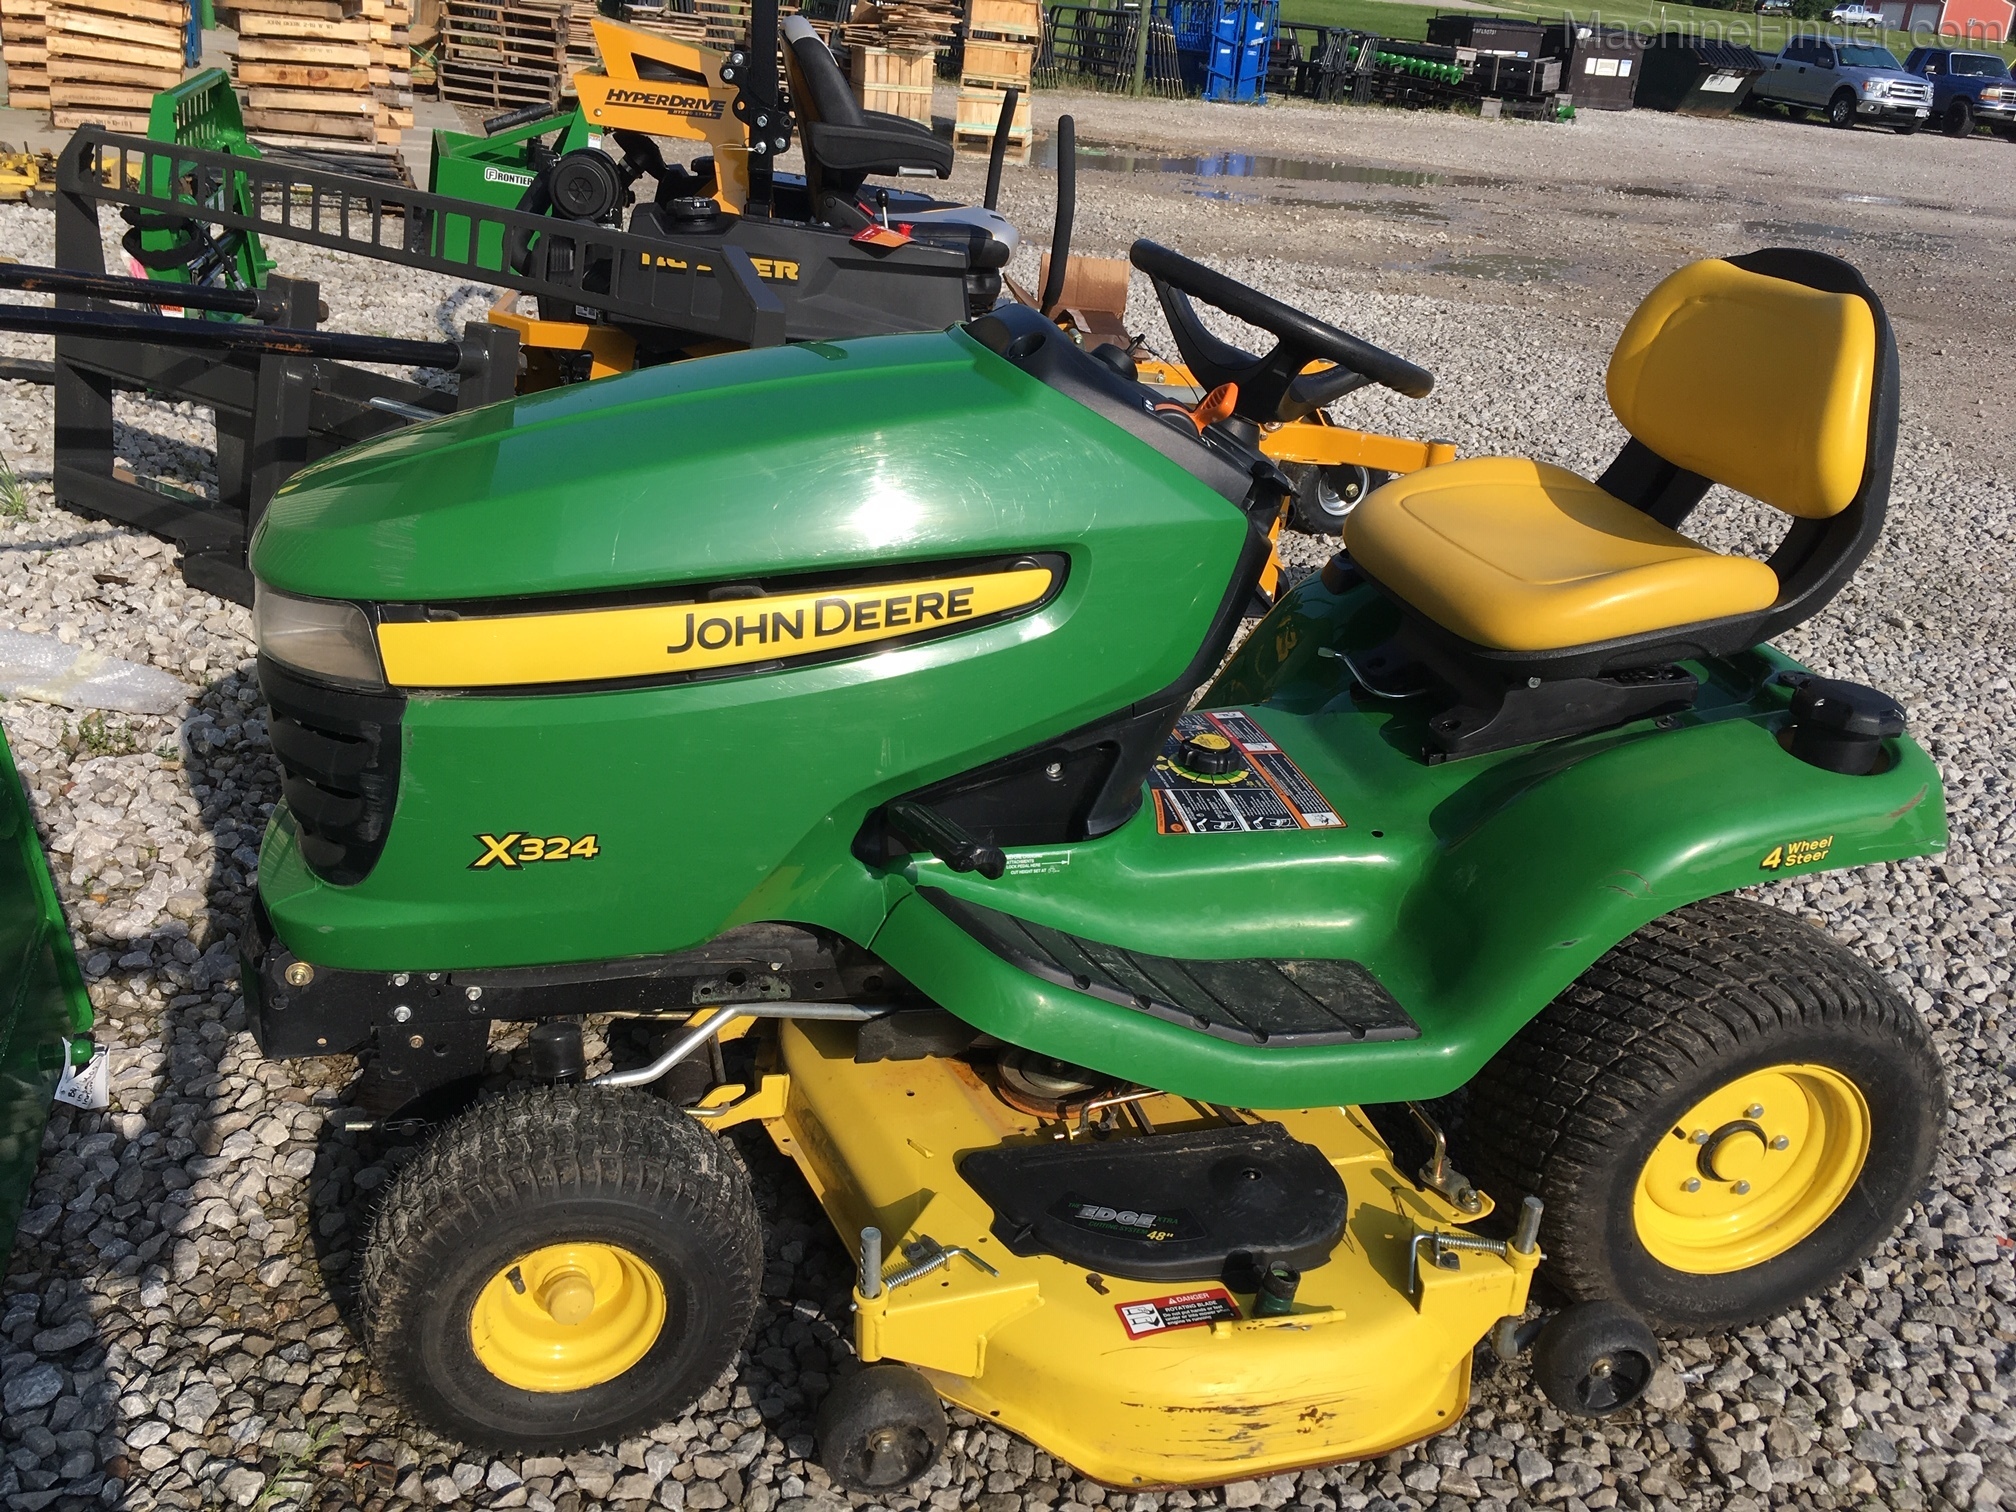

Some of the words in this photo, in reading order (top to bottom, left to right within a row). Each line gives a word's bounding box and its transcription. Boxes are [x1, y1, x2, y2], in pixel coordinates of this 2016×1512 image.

[485, 168, 533, 186] FRONTIER
[667, 610, 804, 655] JOHN
[815, 587, 974, 637] DEERE
[470, 832, 600, 869] X324
[1761, 845, 1783, 870] 4
[1788, 835, 1834, 855] Wheel
[1784, 850, 1829, 867] Steer
[1075, 1204, 1157, 1229] EDGE
[1088, 1221, 1118, 1231] CUTTING
[1119, 1225, 1149, 1235] SYSTEM
[1147, 1230, 1174, 1241] 48"
[1164, 1303, 1196, 1312] ROTATING
[1196, 1300, 1218, 1308] BLADE
[1176, 1292, 1210, 1303] DANGER
